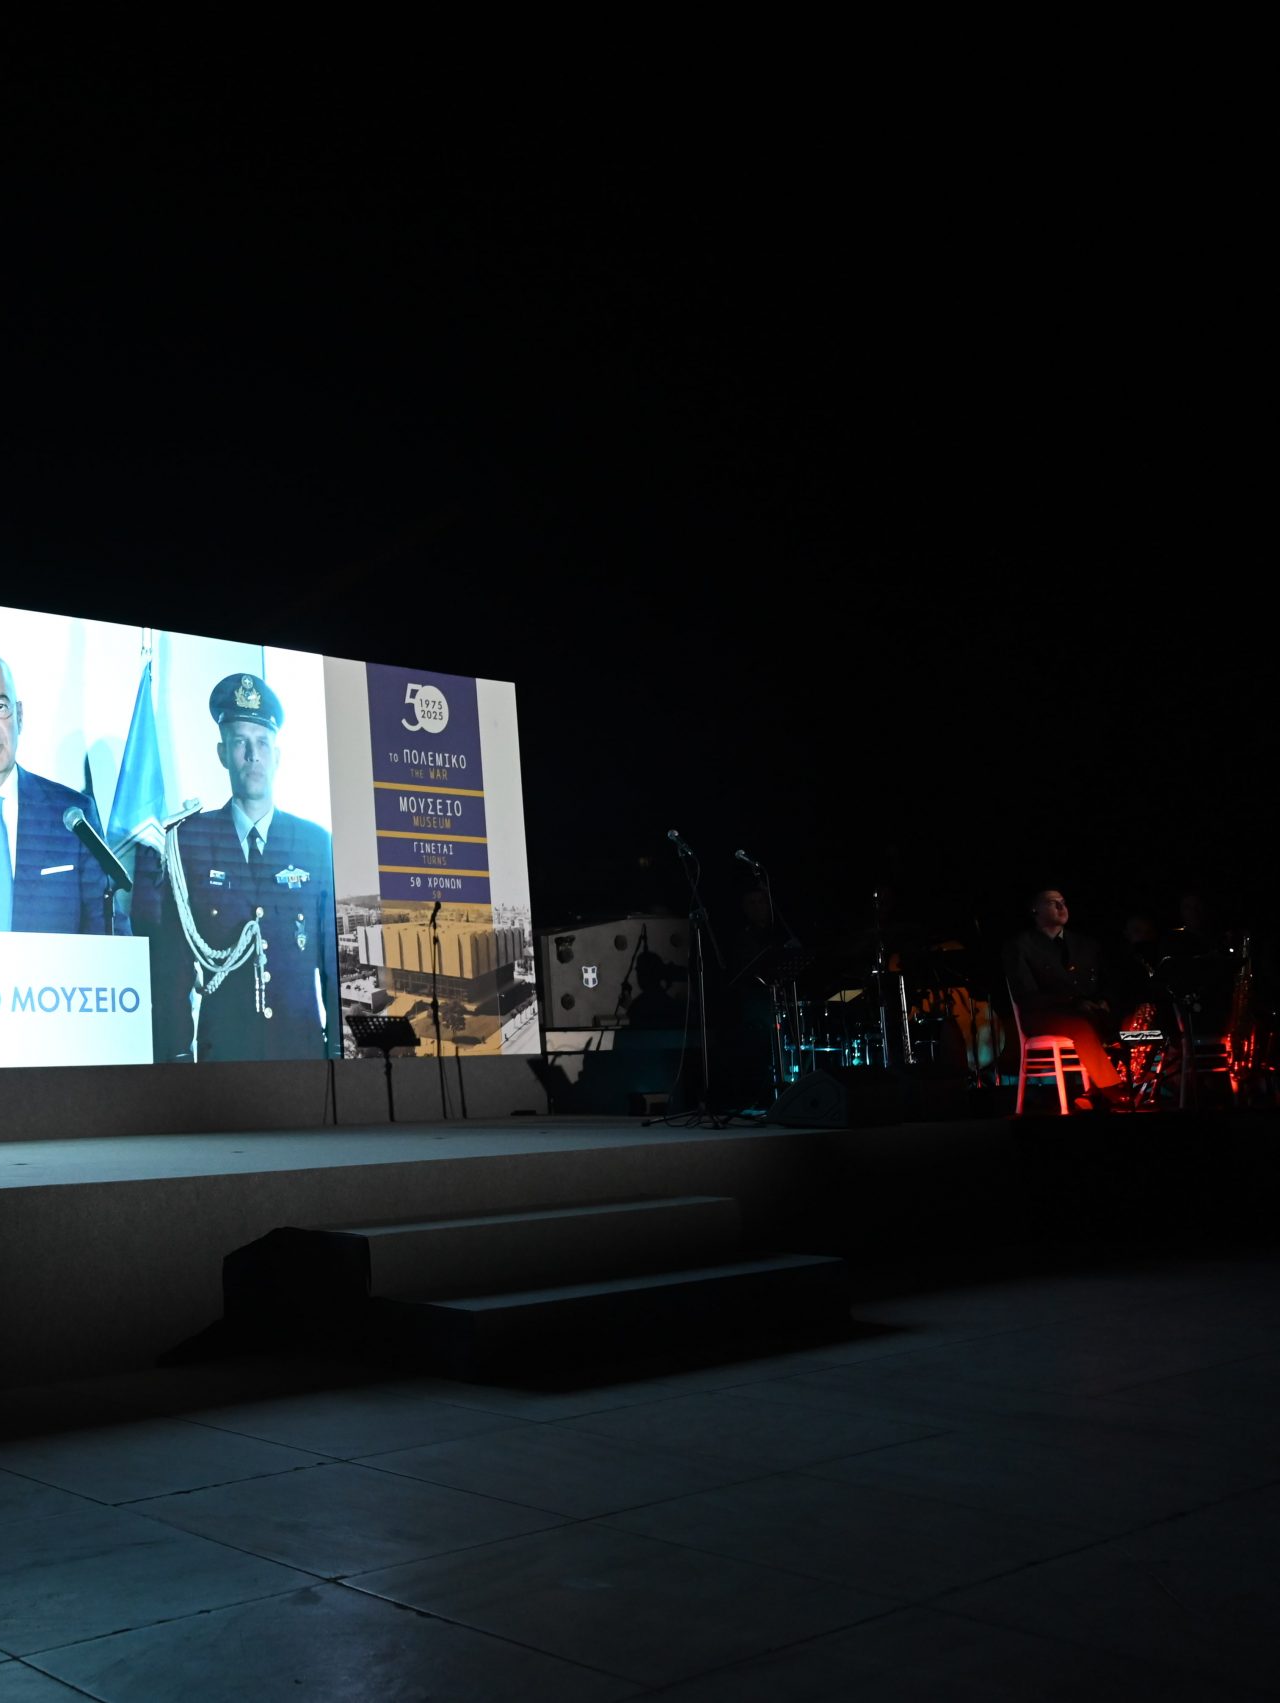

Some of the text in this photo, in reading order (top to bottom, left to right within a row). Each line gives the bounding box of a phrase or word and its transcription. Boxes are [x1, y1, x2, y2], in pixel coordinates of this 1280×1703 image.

[420, 699, 442, 710] 1975
[421, 709, 443, 720] 2025
[403, 749, 467, 769] ΠΟΛΕΜΙΚΟ
[410, 768, 448, 780] THE WAR
[399, 796, 462, 816] ΜΟΥΣΕΙΟ
[413, 816, 452, 829] MUSEUM
[413, 842, 454, 855] ΓΙΝΕΤΑΙ
[422, 855, 447, 866] TURNS
[410, 877, 462, 889] 50 ΧΡΟΝΩΝ
[432, 891, 442, 899] 50
[11, 986, 140, 1013] ΜΟΥΣΕΙΟ
